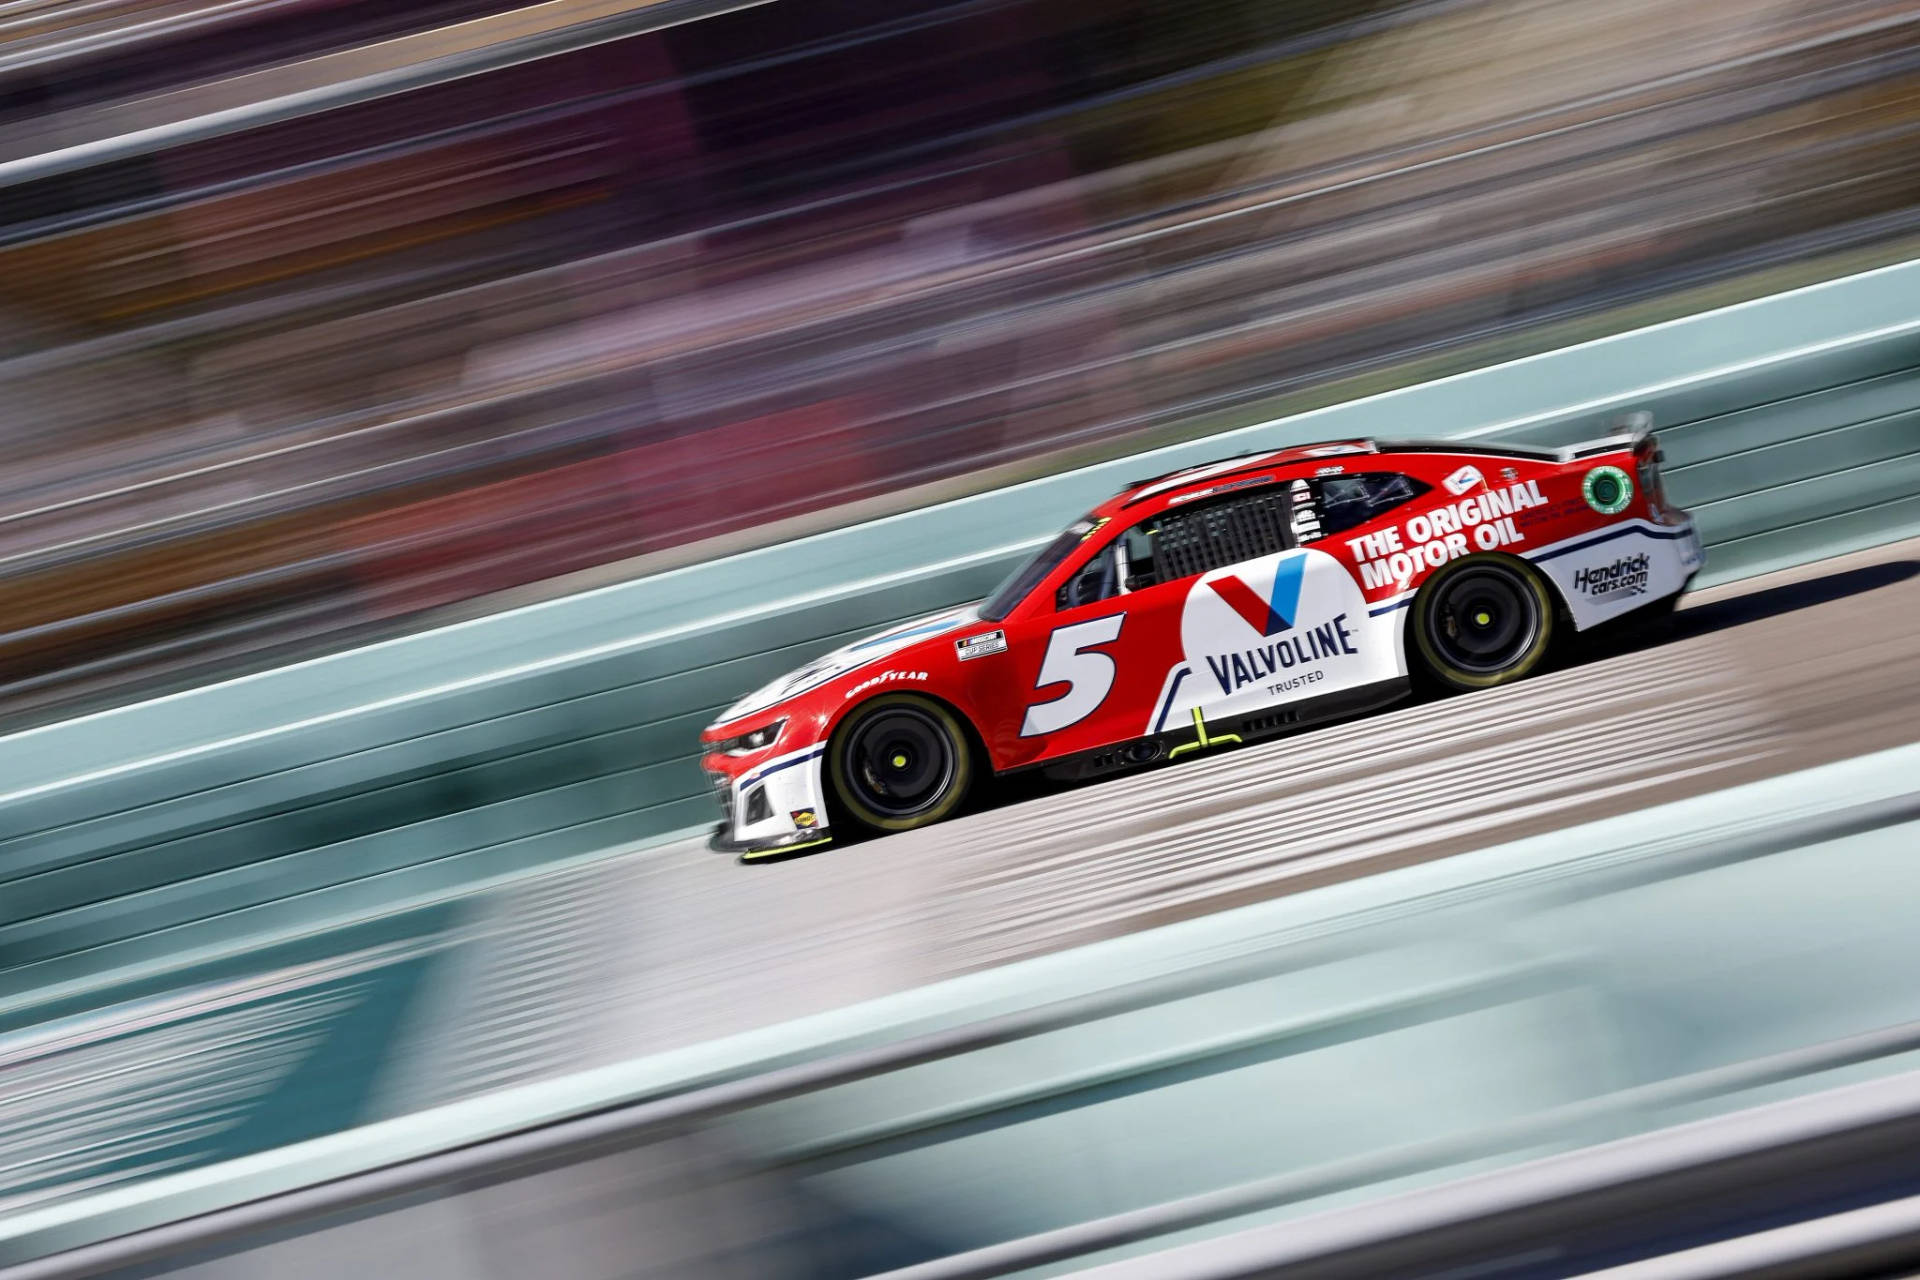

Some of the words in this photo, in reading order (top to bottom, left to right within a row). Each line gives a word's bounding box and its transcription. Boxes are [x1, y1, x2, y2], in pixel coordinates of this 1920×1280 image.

[1345, 526, 1404, 563] THE
[1406, 480, 1549, 543] ORIGINAL
[1359, 532, 1470, 590] MOTOR
[1474, 517, 1525, 551] OIL
[1574, 552, 1650, 593] Hendrick
[1591, 571, 1649, 596] cars.com
[1019, 611, 1127, 738] 5
[1206, 613, 1358, 696] VALVOLINE
[1267, 670, 1324, 696] TRUSTED
[845, 669, 929, 699] GOODYEAR
